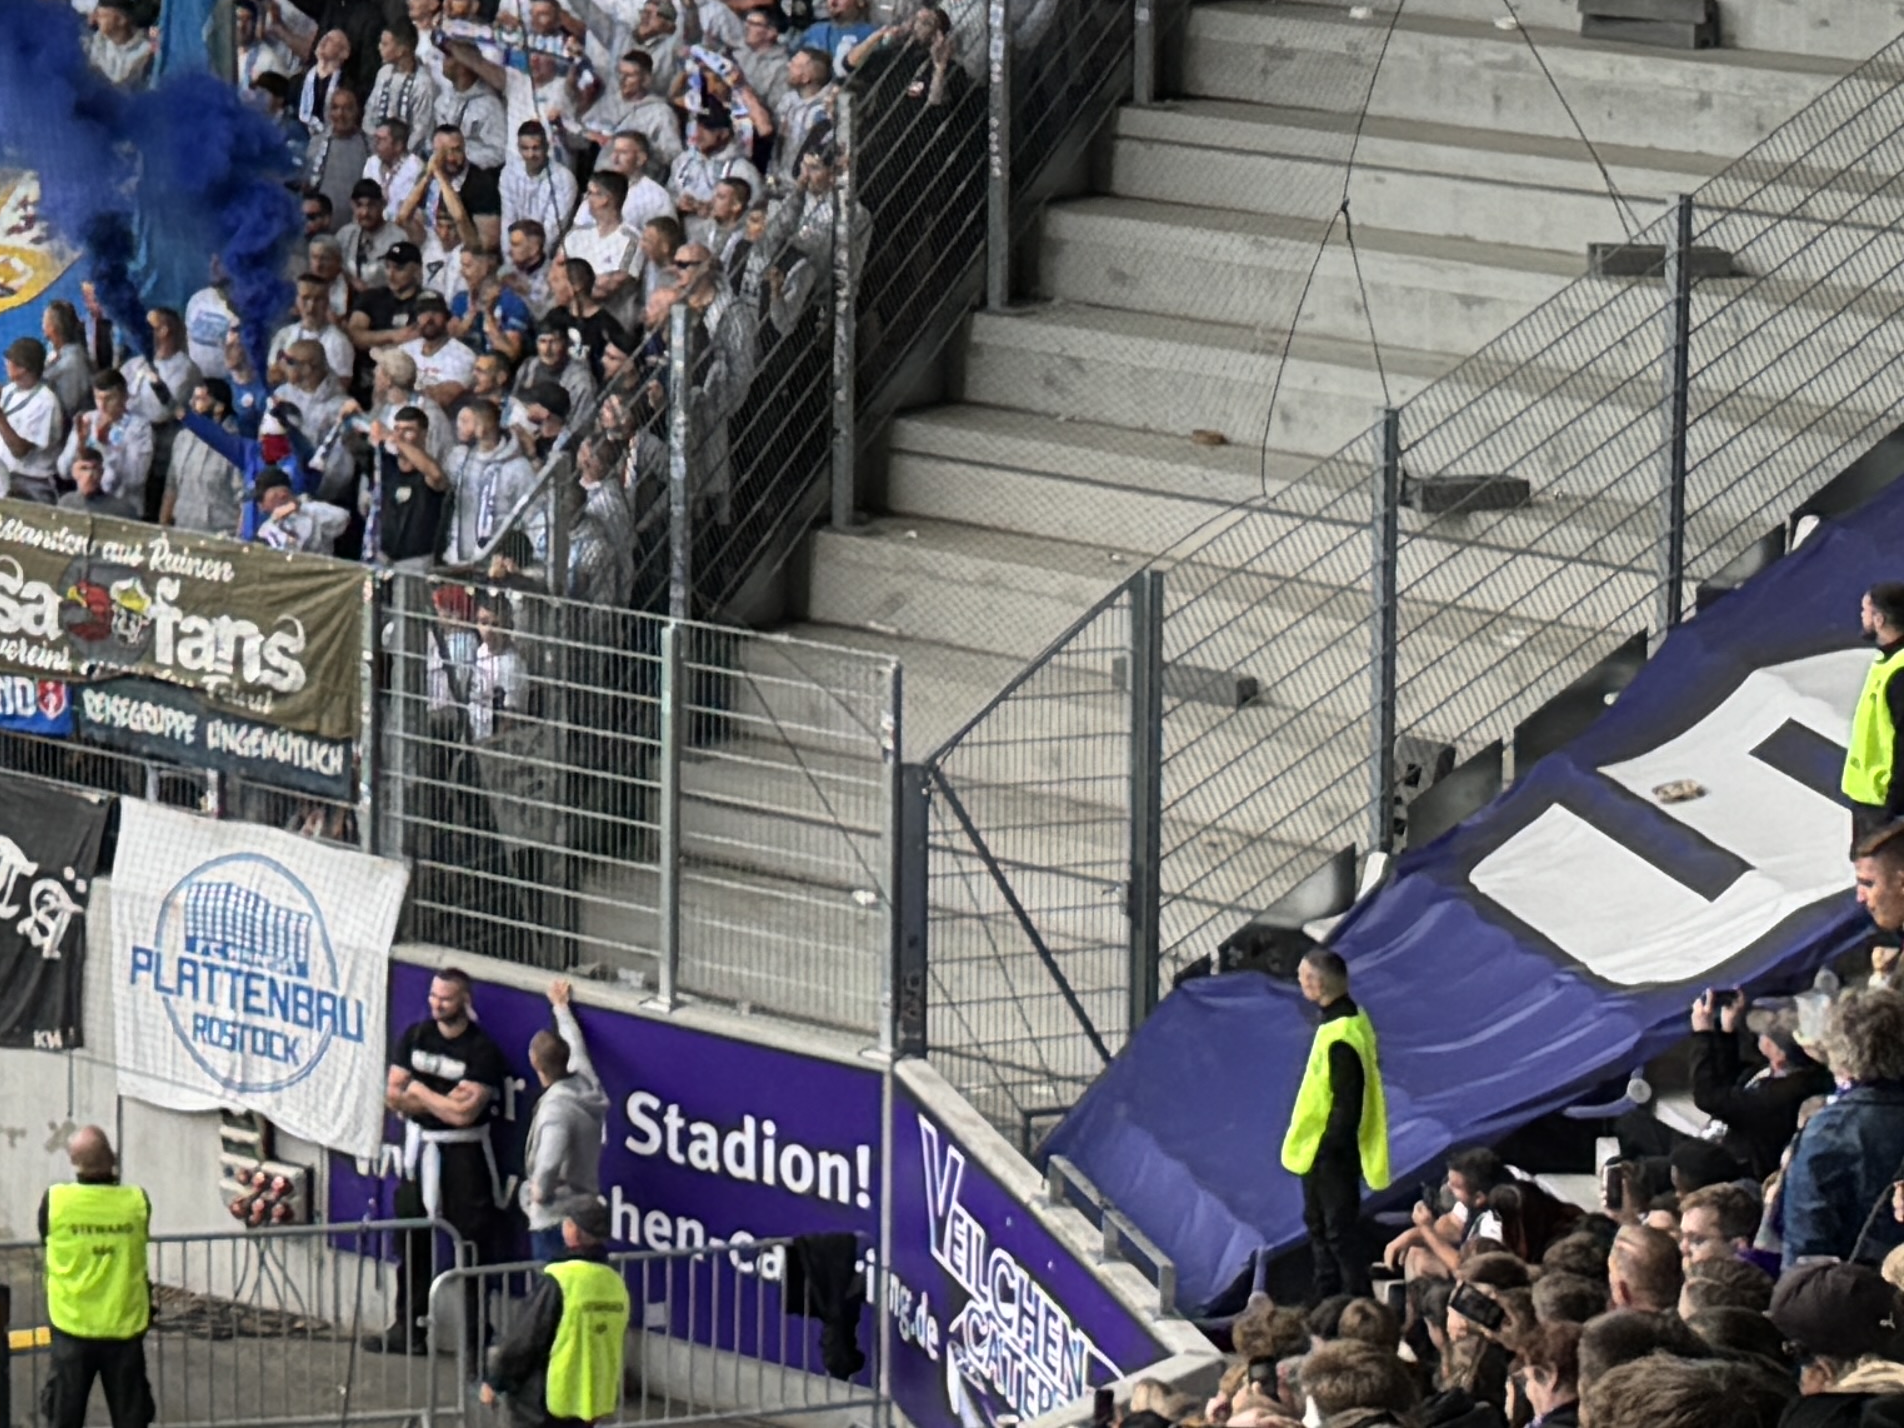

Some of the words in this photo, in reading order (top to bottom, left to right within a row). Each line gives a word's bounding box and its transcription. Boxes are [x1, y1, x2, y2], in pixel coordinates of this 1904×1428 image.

[147, 532, 235, 584] Ruinen
[149, 578, 308, 694] fans
[130, 945, 366, 1045] PLATTENBAU
[192, 1011, 301, 1067] ROSTOCK
[624, 1090, 872, 1209] Stadion!
[918, 1112, 1090, 1400] VEILCHEN
